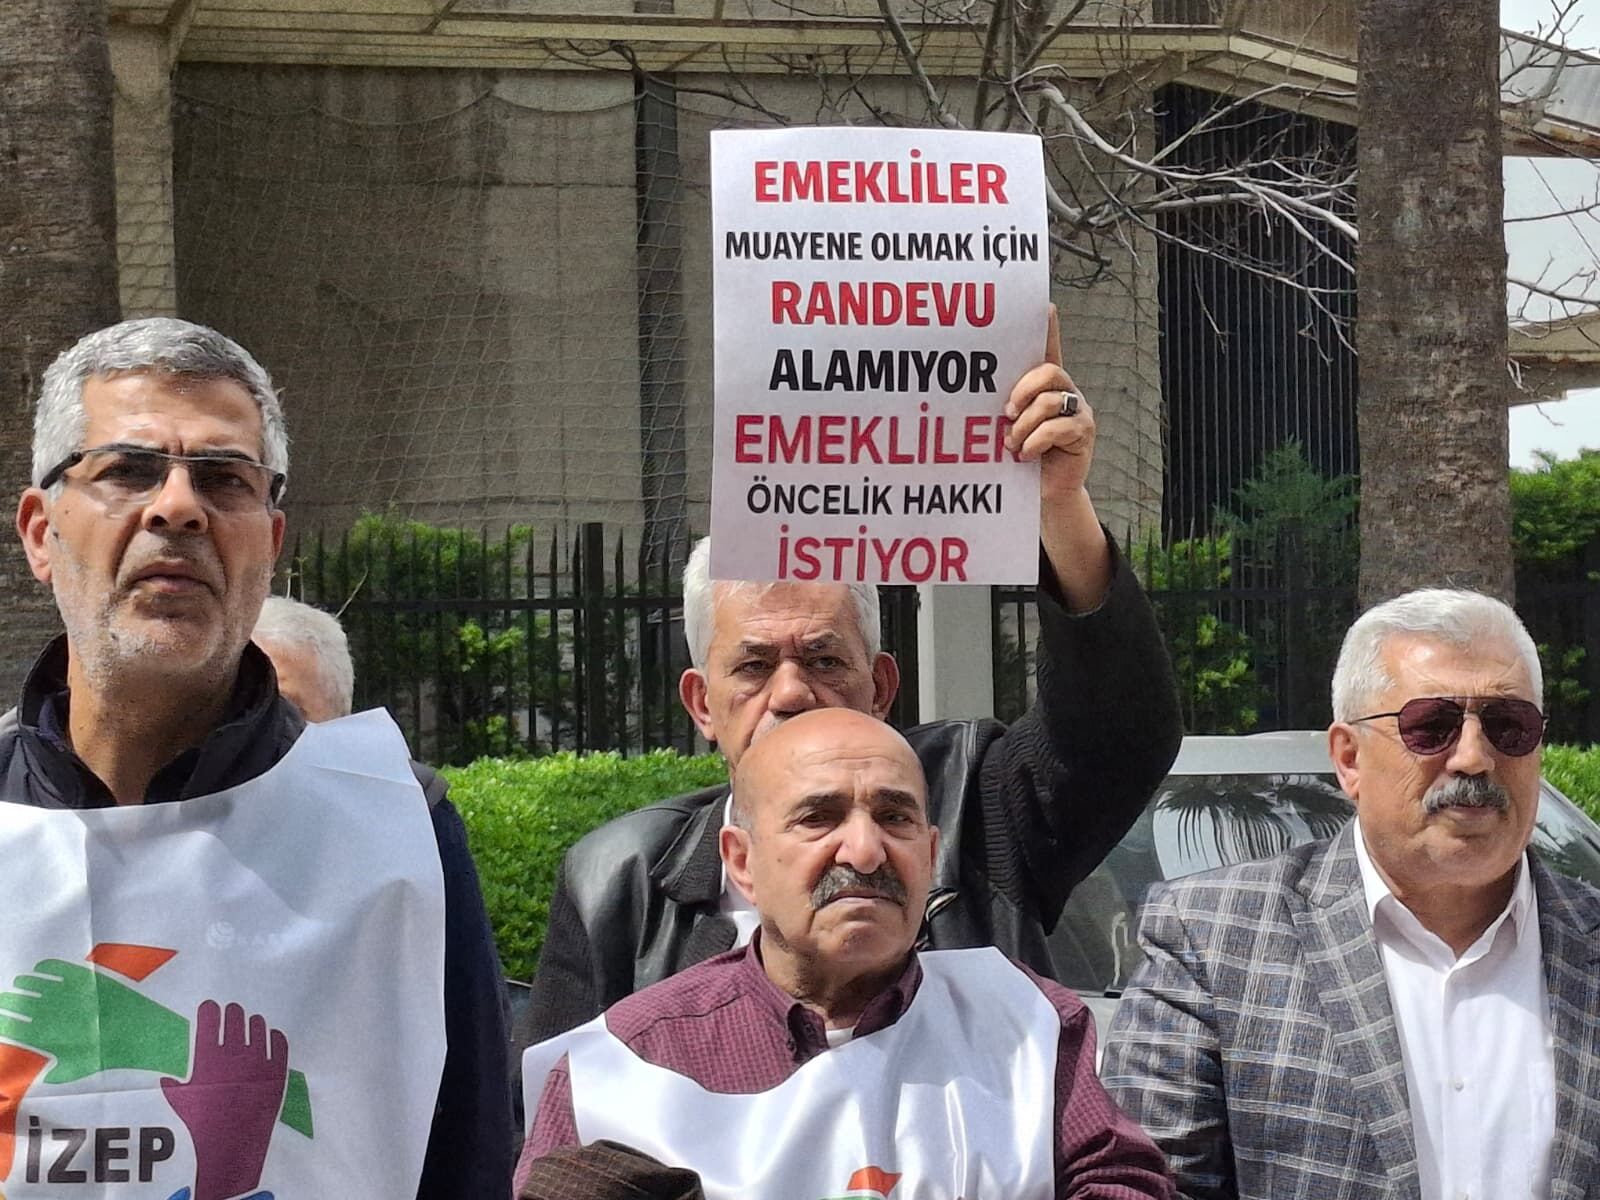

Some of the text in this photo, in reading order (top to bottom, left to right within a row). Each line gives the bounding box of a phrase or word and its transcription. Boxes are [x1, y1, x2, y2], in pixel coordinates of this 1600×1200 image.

[755, 149, 1008, 204] EMEKLİLER
[725, 225, 1038, 268] MUAYENE OLMAK İÇİN
[771, 281, 995, 327] RANDEVU
[769, 349, 997, 393] ALAMIYOR
[747, 476, 1002, 514] ÖNCELİK HAKKI
[778, 525, 969, 582] İSTİYOR
[25, 1116, 175, 1183] İZEP
